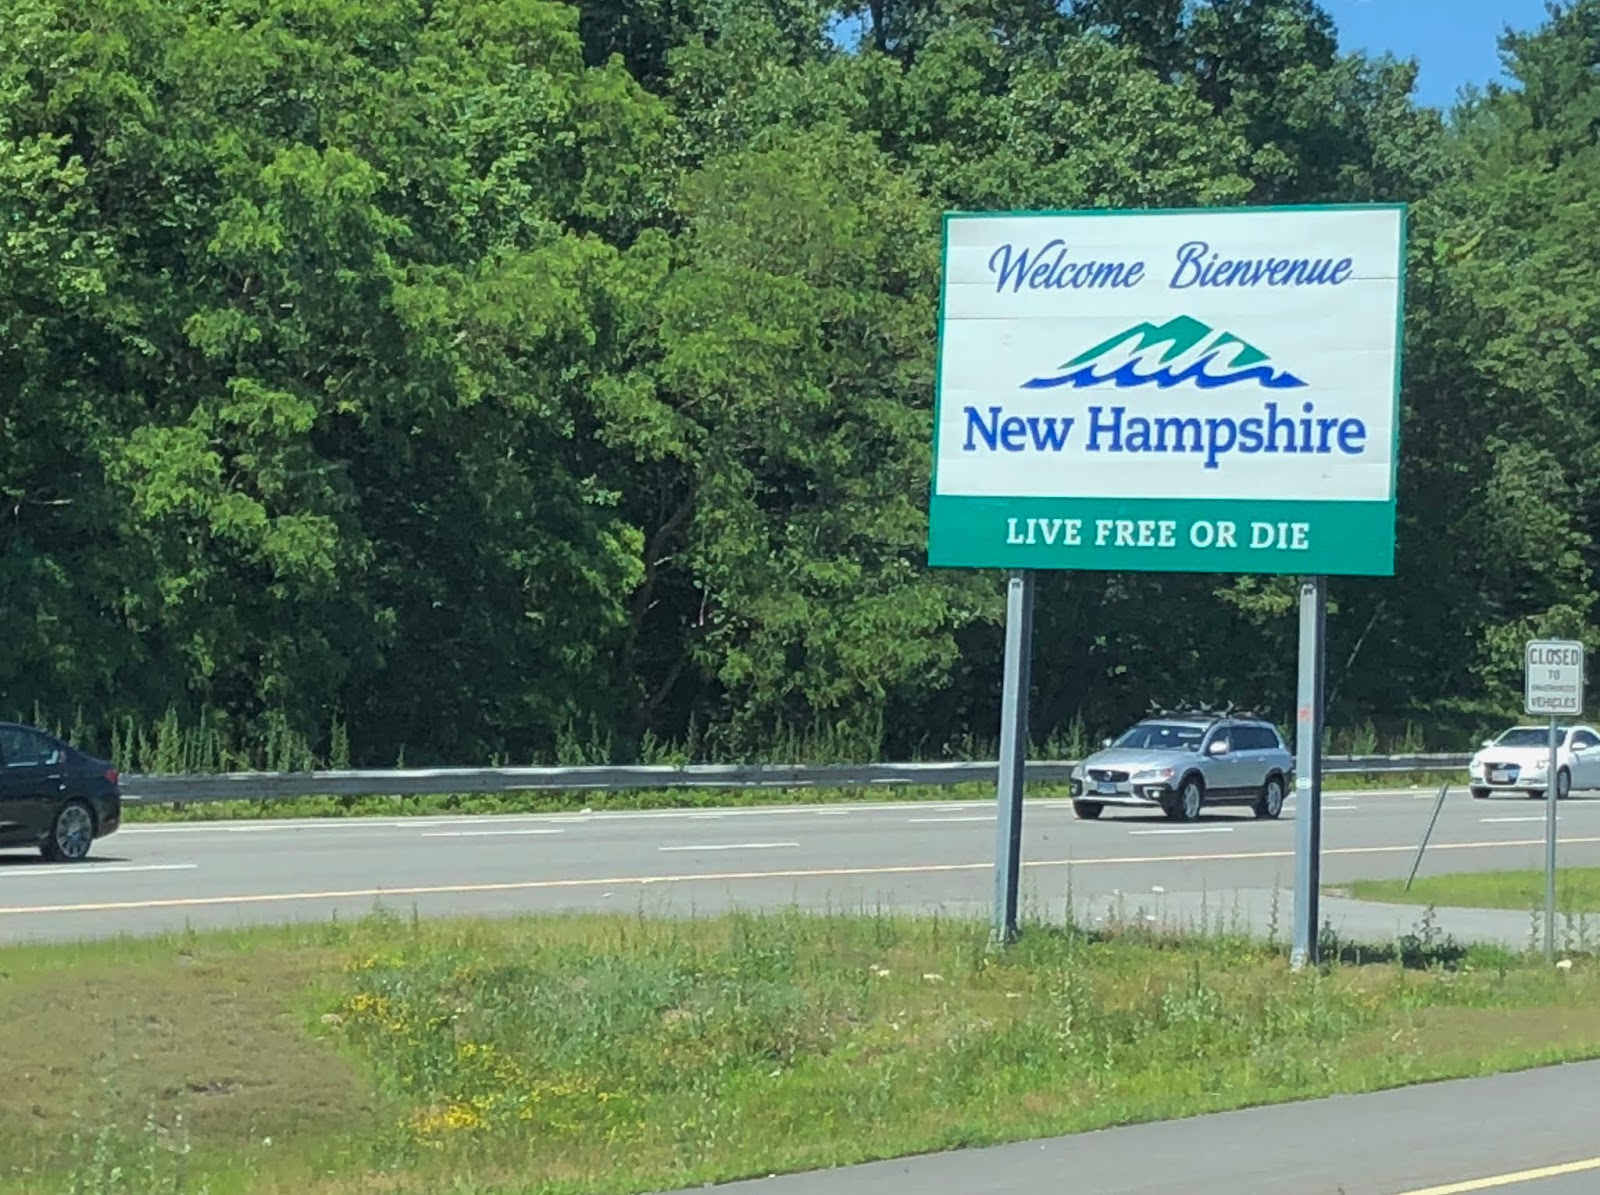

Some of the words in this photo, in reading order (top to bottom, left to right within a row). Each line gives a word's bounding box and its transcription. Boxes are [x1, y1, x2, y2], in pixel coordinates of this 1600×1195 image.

[988, 239, 1145, 293] Welcome
[1168, 241, 1353, 289] Bienvenue
[963, 407, 1073, 451] New
[1085, 402, 1366, 468] Hampshire
[1006, 518, 1082, 545] LIVE
[1095, 520, 1176, 547] FREE
[1189, 521, 1237, 549] OR
[1249, 523, 1310, 550] DIE
[1530, 648, 1579, 666] CLOSED
[1548, 669, 1560, 680] TO
